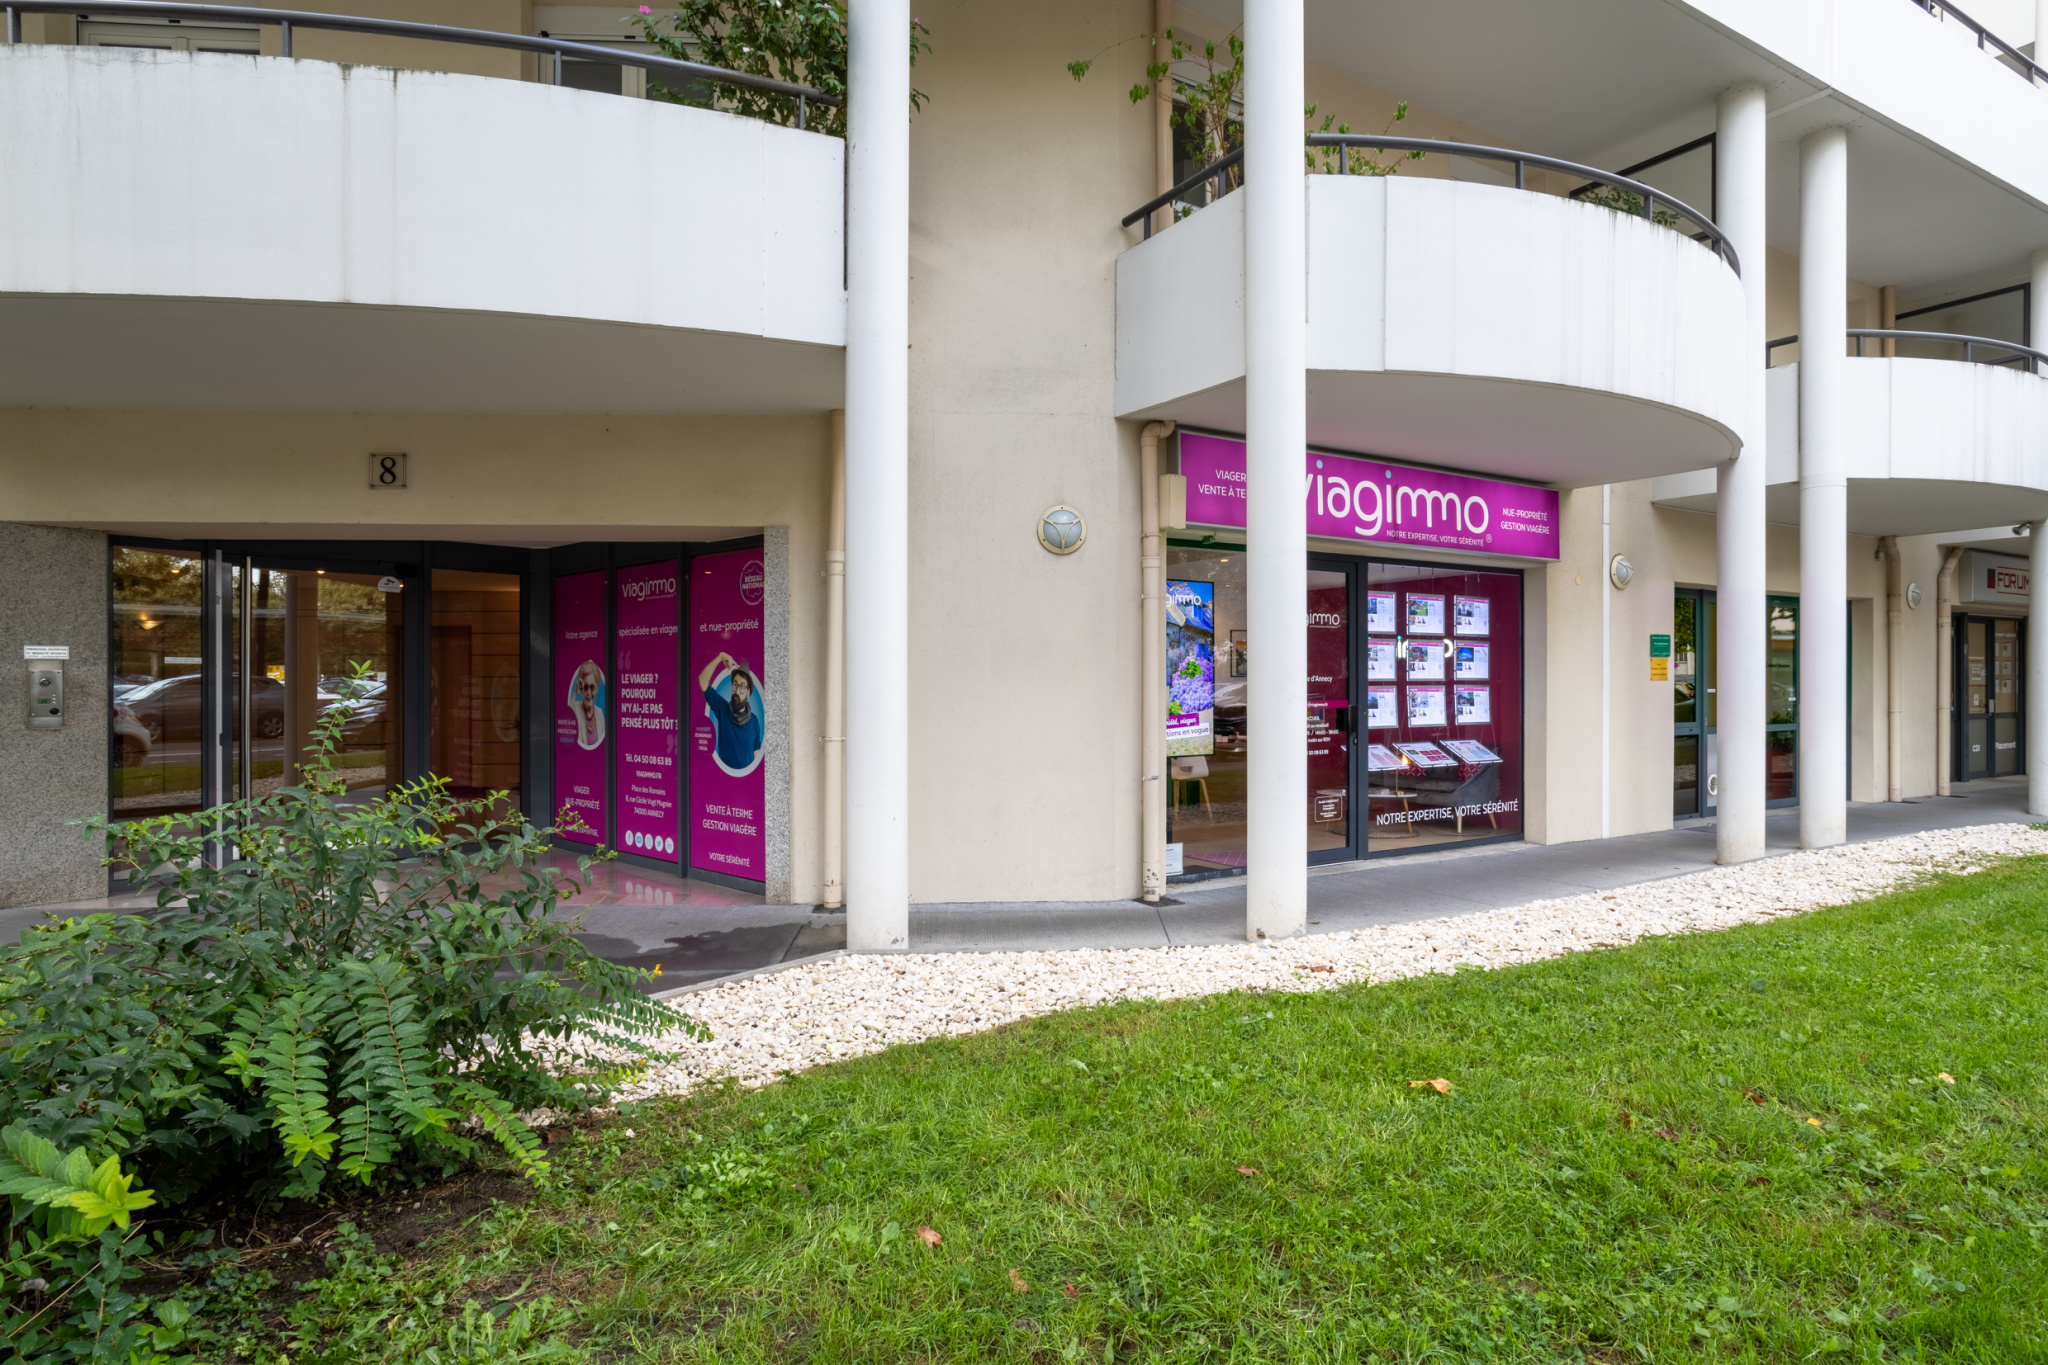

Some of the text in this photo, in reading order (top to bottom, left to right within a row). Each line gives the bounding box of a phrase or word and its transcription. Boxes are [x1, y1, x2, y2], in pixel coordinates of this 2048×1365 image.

[379, 456, 396, 485] 8
[1215, 469, 1246, 482] VIAGER
[1198, 484, 1246, 498] VENTE À TE
[1502, 507, 1548, 521] NUE-PROPRIÉTÉ
[1500, 521, 1550, 534] GESTION VIAGÈRE
[1386, 529, 1484, 546] NOTRE EXPERTISE, VOTRE SÉRÉNITÉ
[744, 574, 762, 583] RÉSEAU
[1997, 572, 2030, 590] FORUM
[622, 577, 676, 601] viagimmo
[1166, 588, 1202, 608] gimmo
[1306, 609, 1340, 626] immo
[618, 625, 649, 638] spécialisée
[700, 618, 759, 633] et nue-propriété
[565, 630, 598, 641] Votre agence
[621, 673, 659, 684] LE VIAGER ?
[1311, 675, 1332, 683] d'Annecy
[621, 688, 656, 700] POURQUOI
[621, 702, 663, 714] N'Y AI-JE PAS
[621, 715, 642, 728] PENSÉ
[643, 718, 660, 729] PLUS
[661, 716, 674, 730] TÔT
[1191, 727, 1209, 736] vogue
[1972, 741, 2016, 752] CDI Placement
[625, 754, 672, 766] Tél. 04 50 08 63 89
[636, 770, 662, 780] VIAGIMMO.FR
[574, 785, 590, 795] VIAGER
[631, 784, 642, 793] Place
[649, 787, 666, 796] Romains
[565, 797, 600, 810] NUE-PROPRIÉTÉ
[633, 807, 665, 818] 74000 ANNECY
[706, 804, 753, 819] VENTE À TERME
[1376, 798, 1519, 826] NOTRE EXPERTISE, VOTRE SÉRÉNITÉ
[702, 819, 757, 836] GESTION VIAGÈRE
[709, 852, 750, 867] VOTRE SÉRÉNITÉ
